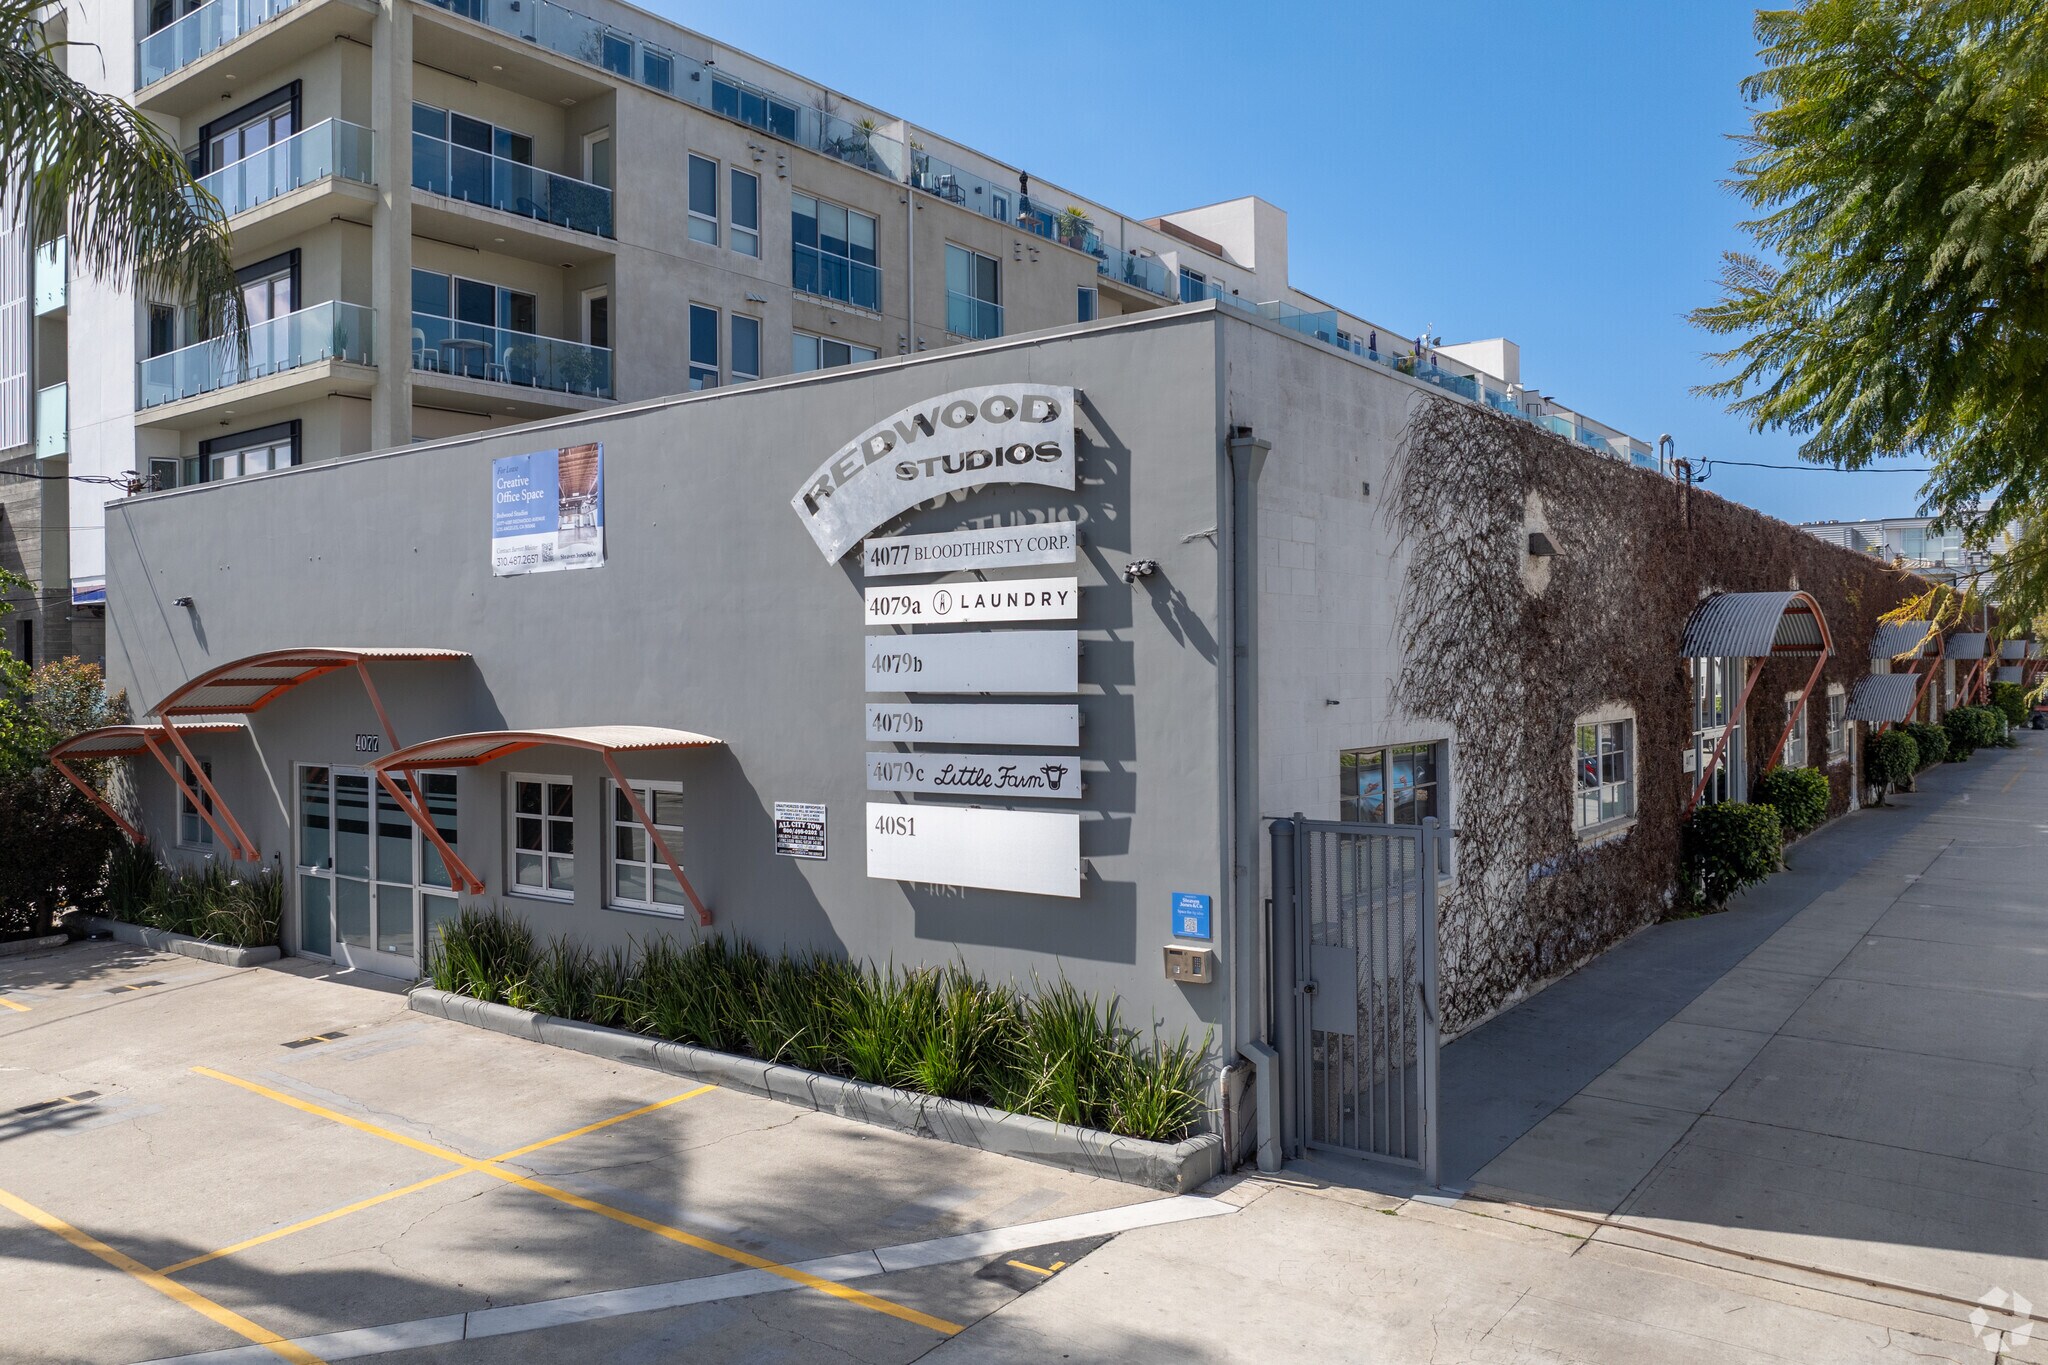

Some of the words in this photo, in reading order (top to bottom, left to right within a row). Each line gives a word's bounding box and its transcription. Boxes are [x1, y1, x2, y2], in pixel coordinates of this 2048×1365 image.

[803, 394, 1062, 517] REDWOOD
[896, 440, 1063, 482] STUDIOS
[496, 475, 529, 489] Creative
[496, 490, 520, 503] Office
[521, 488, 544, 503] Space
[497, 554, 538, 566] 310.487.2657
[870, 545, 910, 567] 4077
[914, 538, 1024, 561] BLOODTHIRSTY
[1027, 534, 1070, 552] CORP.
[869, 595, 922, 616] 4079a
[961, 590, 1069, 609] LAUNDRY
[872, 653, 923, 674] 4079b
[872, 712, 924, 733] 4079b
[355, 734, 378, 752] 4077
[873, 761, 925, 782] 4079c
[934, 763, 993, 788] Little
[994, 765, 1045, 789] Farm
